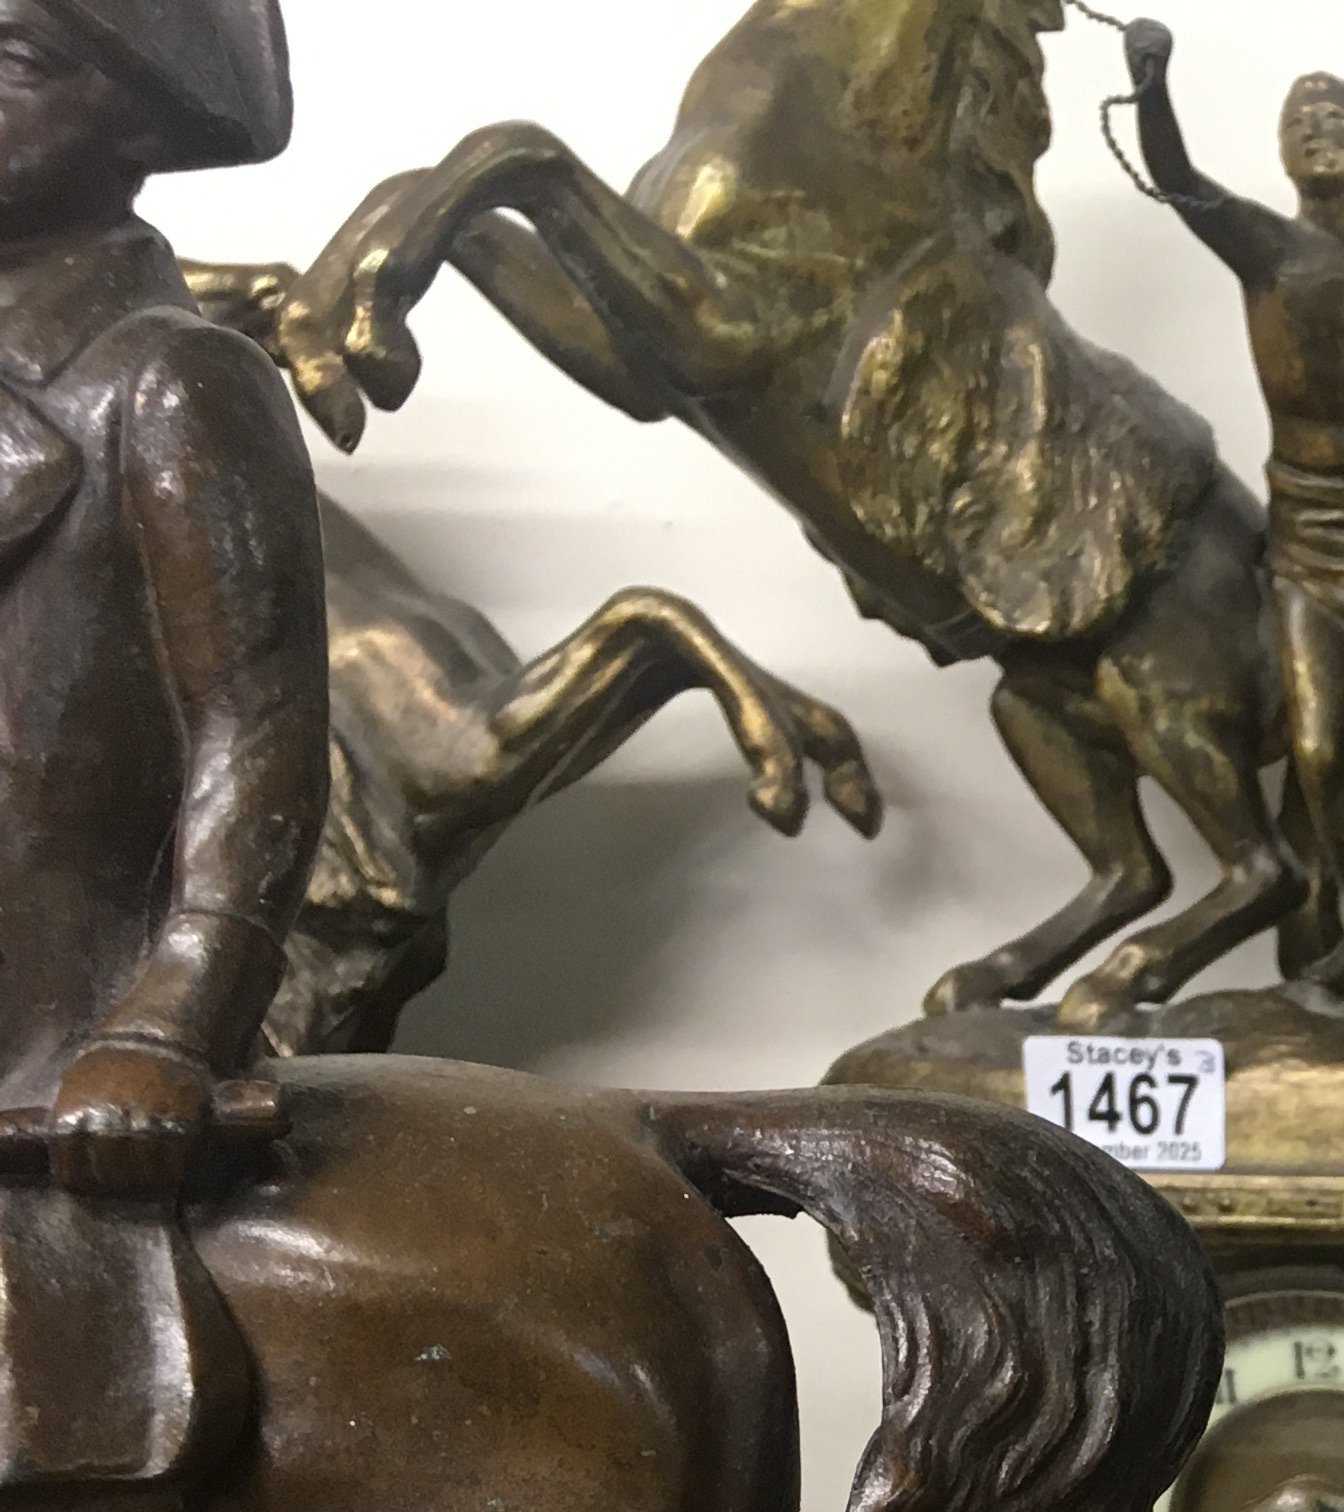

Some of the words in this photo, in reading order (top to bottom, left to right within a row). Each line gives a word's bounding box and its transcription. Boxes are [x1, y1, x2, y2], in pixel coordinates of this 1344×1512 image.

[1066, 1041, 1182, 1072] Stacey's
[1050, 1071, 1199, 1136] 1467
[1101, 1140, 1149, 1160] mber
